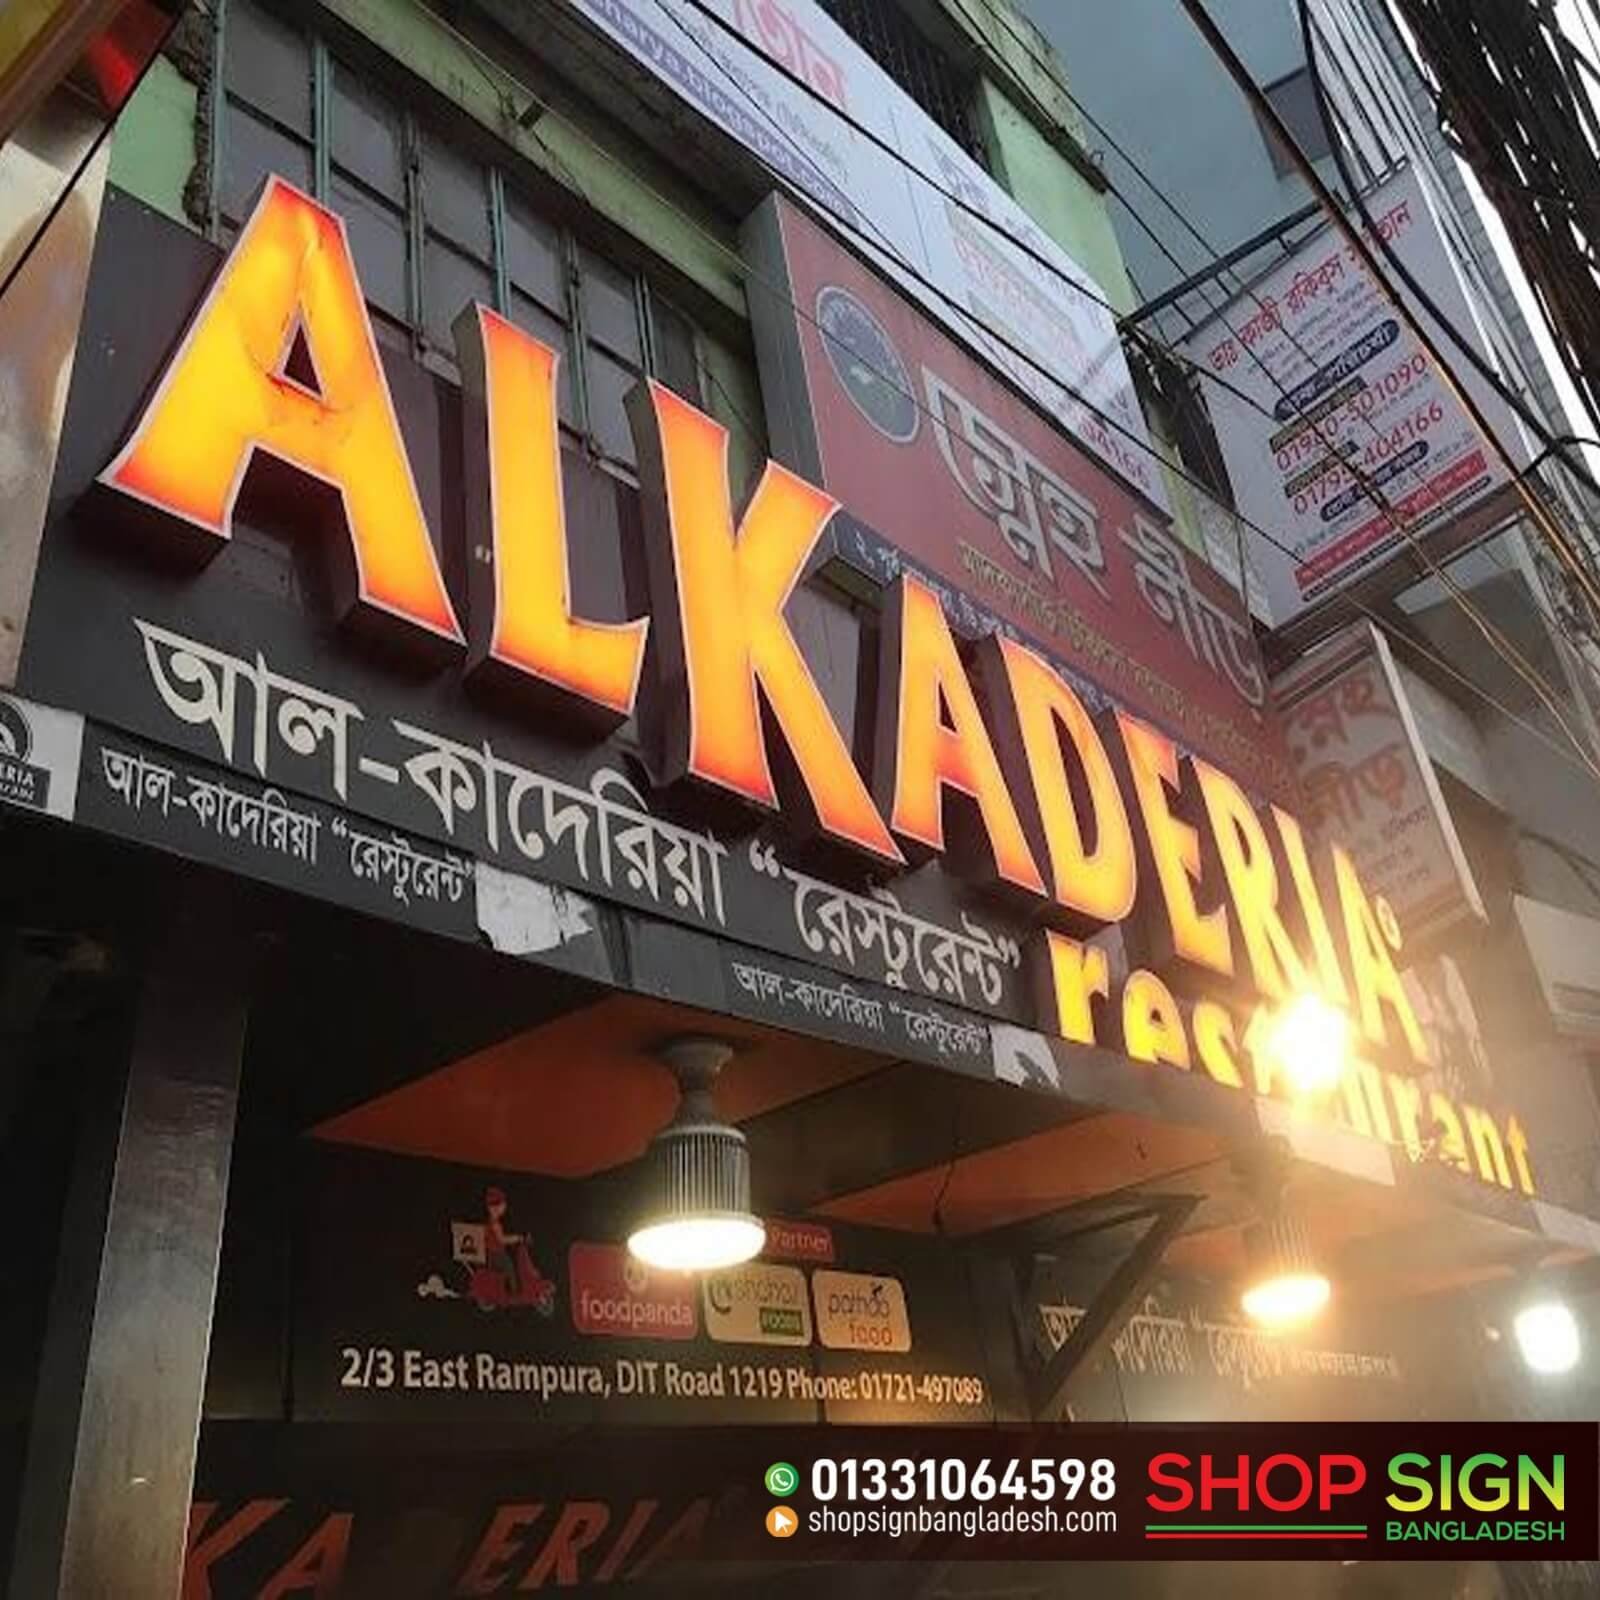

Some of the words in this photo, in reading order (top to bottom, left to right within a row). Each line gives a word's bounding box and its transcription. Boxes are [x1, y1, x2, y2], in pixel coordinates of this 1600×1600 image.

[134, 617, 729, 927] আল-কাদেরিয়া
[580, 1288, 694, 1329] foodpanda
[340, 1347, 396, 1388] 2/3
[403, 1350, 470, 1390] East
[476, 1353, 612, 1400] Rampura,
[616, 1359, 659, 1394] DIT
[665, 1362, 723, 1397] Road
[729, 1367, 783, 1399] 1219
[786, 1367, 858, 1400] Phone:
